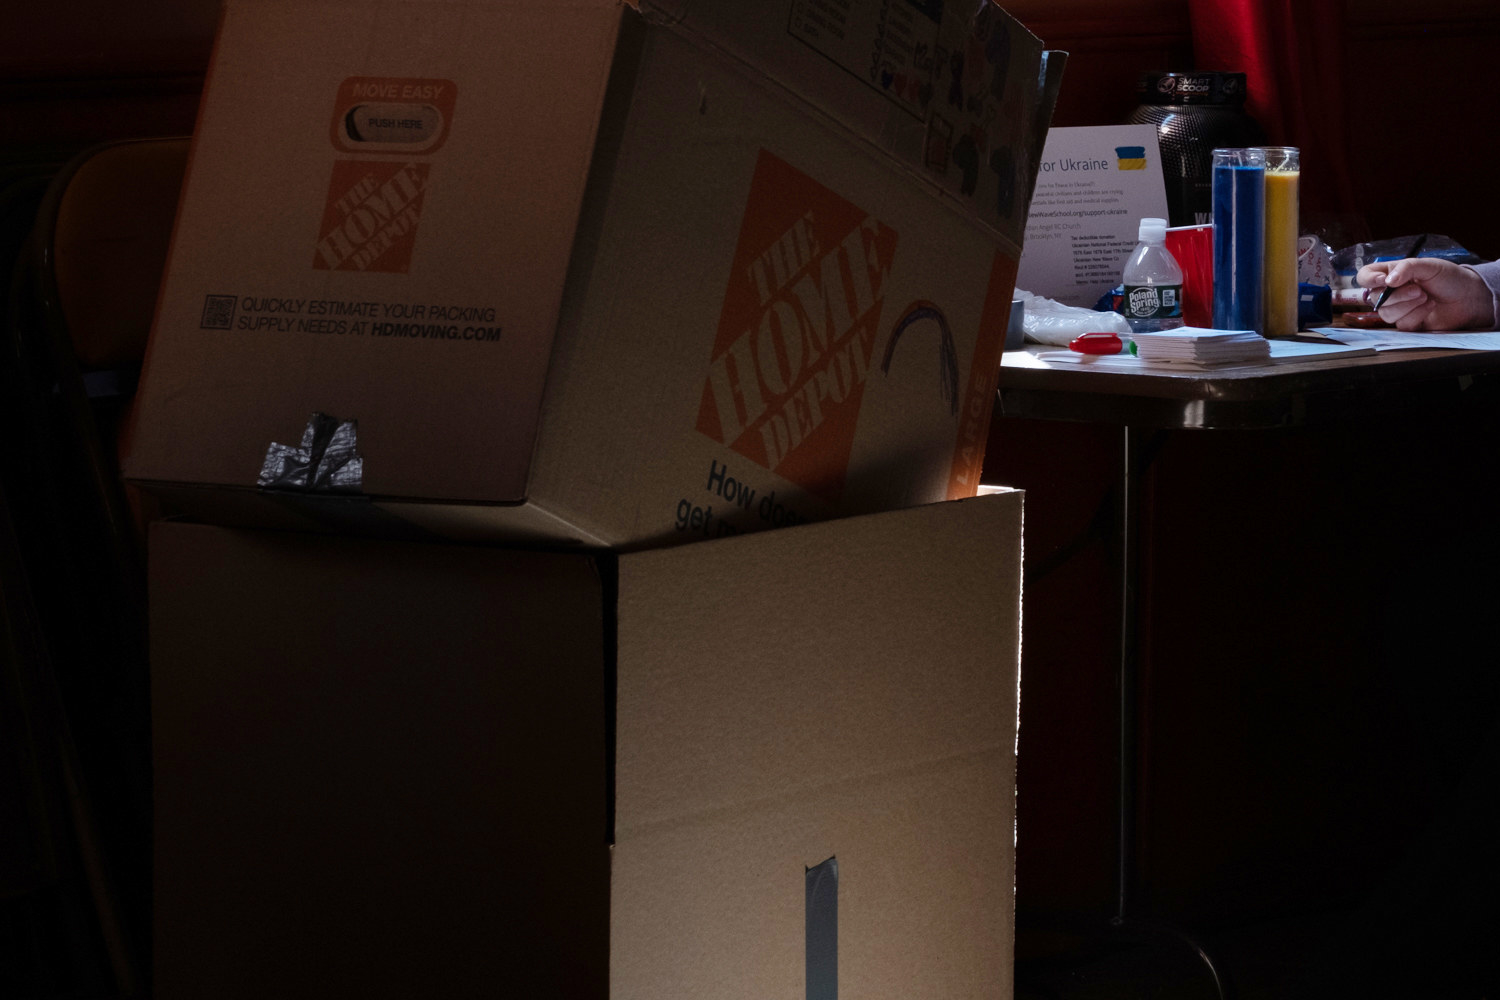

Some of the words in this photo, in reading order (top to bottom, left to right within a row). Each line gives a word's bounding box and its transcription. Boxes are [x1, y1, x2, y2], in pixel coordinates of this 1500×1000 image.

[352, 82, 398, 99] MOVE
[402, 83, 446, 101] EASY
[1178, 77, 1211, 85] SMART
[368, 118, 396, 129] PUSH
[397, 118, 423, 130] HERE
[1059, 158, 1109, 172] Ukraine
[335, 172, 380, 217] THE
[316, 162, 429, 271] HOME
[351, 198, 421, 273] DEPOT
[747, 210, 822, 308] THE
[242, 297, 306, 315] QUICKLY
[308, 300, 379, 318] ESTIMATE
[383, 303, 427, 321] YOUR
[429, 305, 496, 322] PACKING
[1129, 288, 1158, 304] Poland
[1130, 298, 1160, 313] Spring
[237, 315, 297, 334] SUPPLY
[298, 318, 349, 335] NEEDS
[350, 321, 370, 336] AT
[371, 323, 502, 342] HDMOVING.COM
[710, 214, 892, 448] HOME
[758, 331, 871, 472] DEPOT
[955, 373, 987, 487] LARGE
[707, 459, 756, 510] How
[675, 498, 712, 537] get
